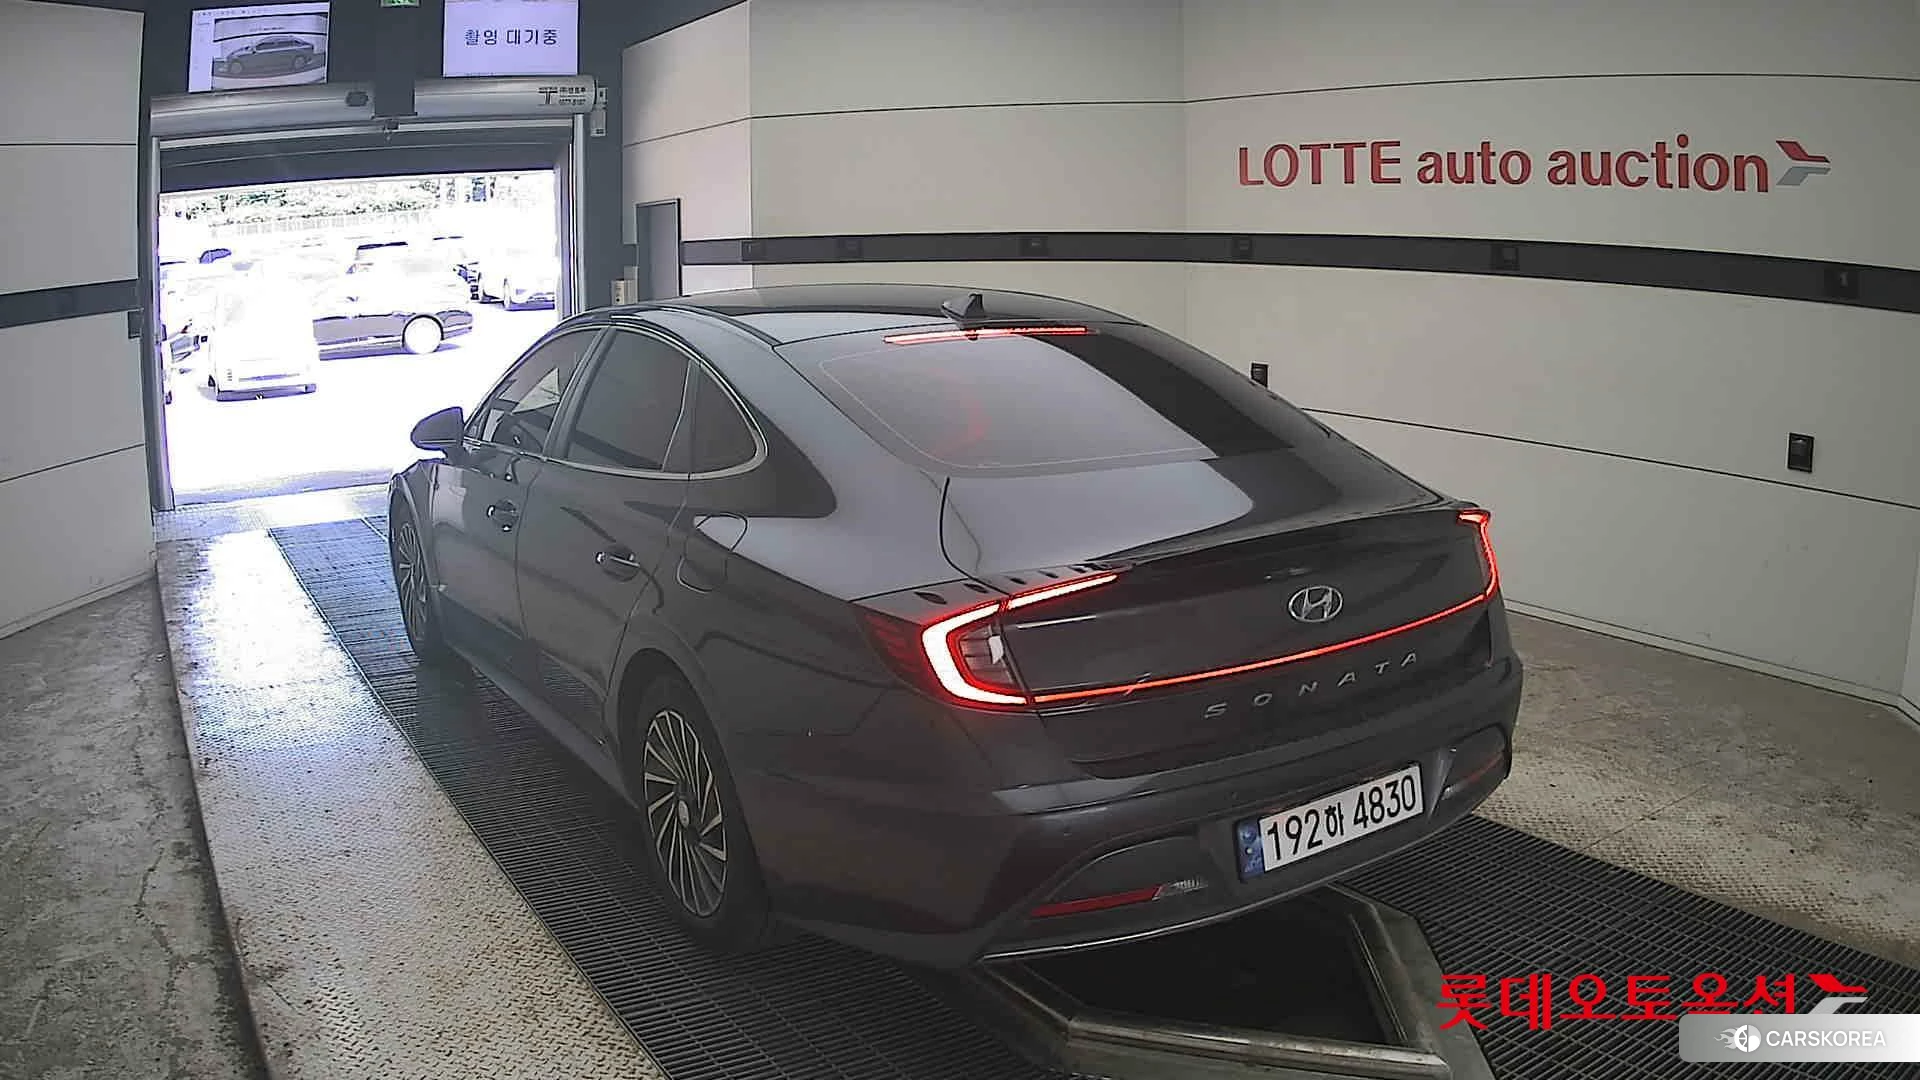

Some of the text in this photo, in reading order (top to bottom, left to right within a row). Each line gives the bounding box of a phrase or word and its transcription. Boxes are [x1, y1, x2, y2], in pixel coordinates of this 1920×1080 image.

[464, 28, 558, 46] 촬영 대기중
[1239, 134, 1769, 193] LOTTE auto auction
[1204, 651, 1418, 719] SONATA
[1267, 775, 1416, 861] 192하 4830
